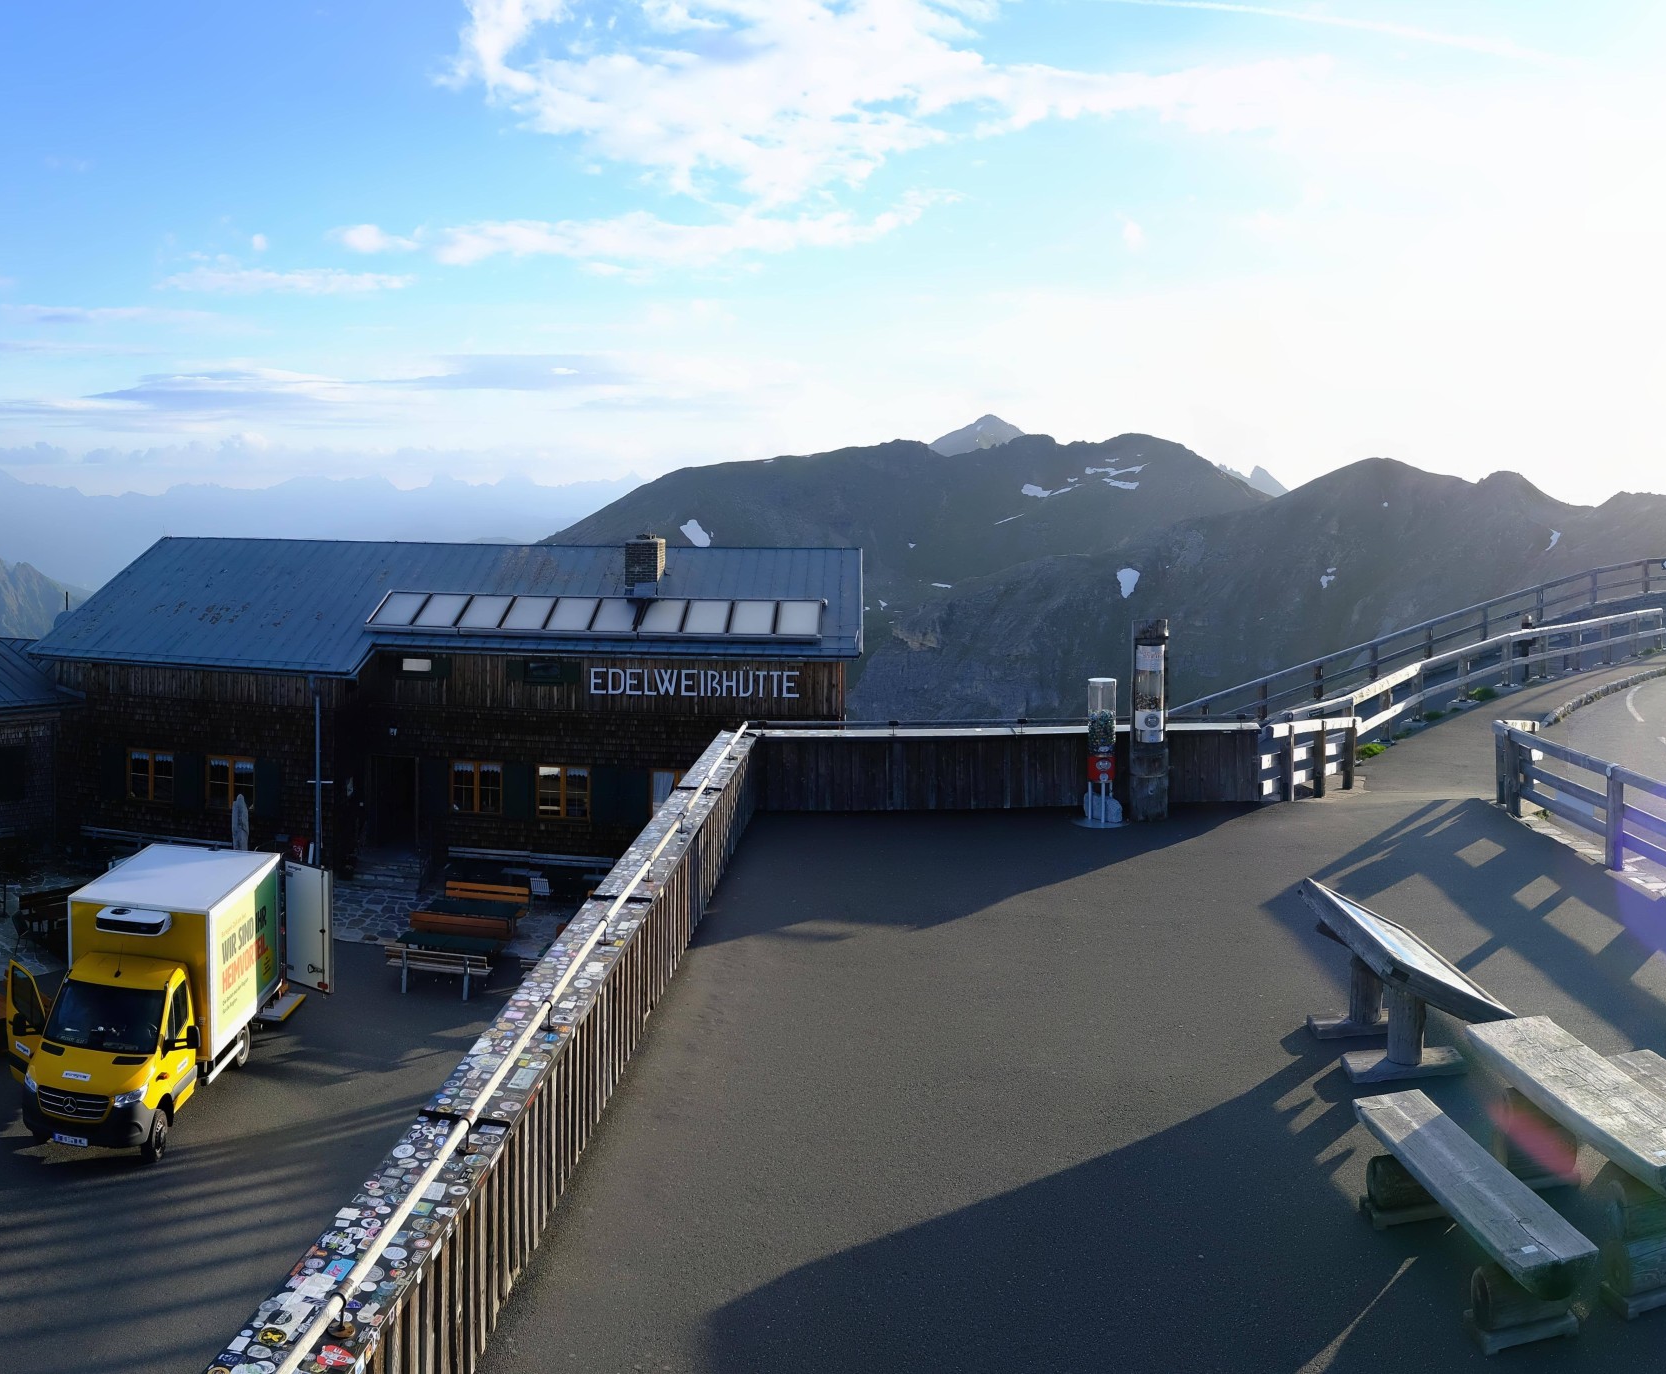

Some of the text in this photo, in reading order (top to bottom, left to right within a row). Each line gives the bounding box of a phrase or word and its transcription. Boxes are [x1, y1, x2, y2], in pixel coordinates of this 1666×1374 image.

[590, 666, 800, 698] EDELWEIßHÜTTE
[222, 932, 237, 965] WIR
[238, 917, 254, 950] SIND
[255, 905, 267, 934] IHR
